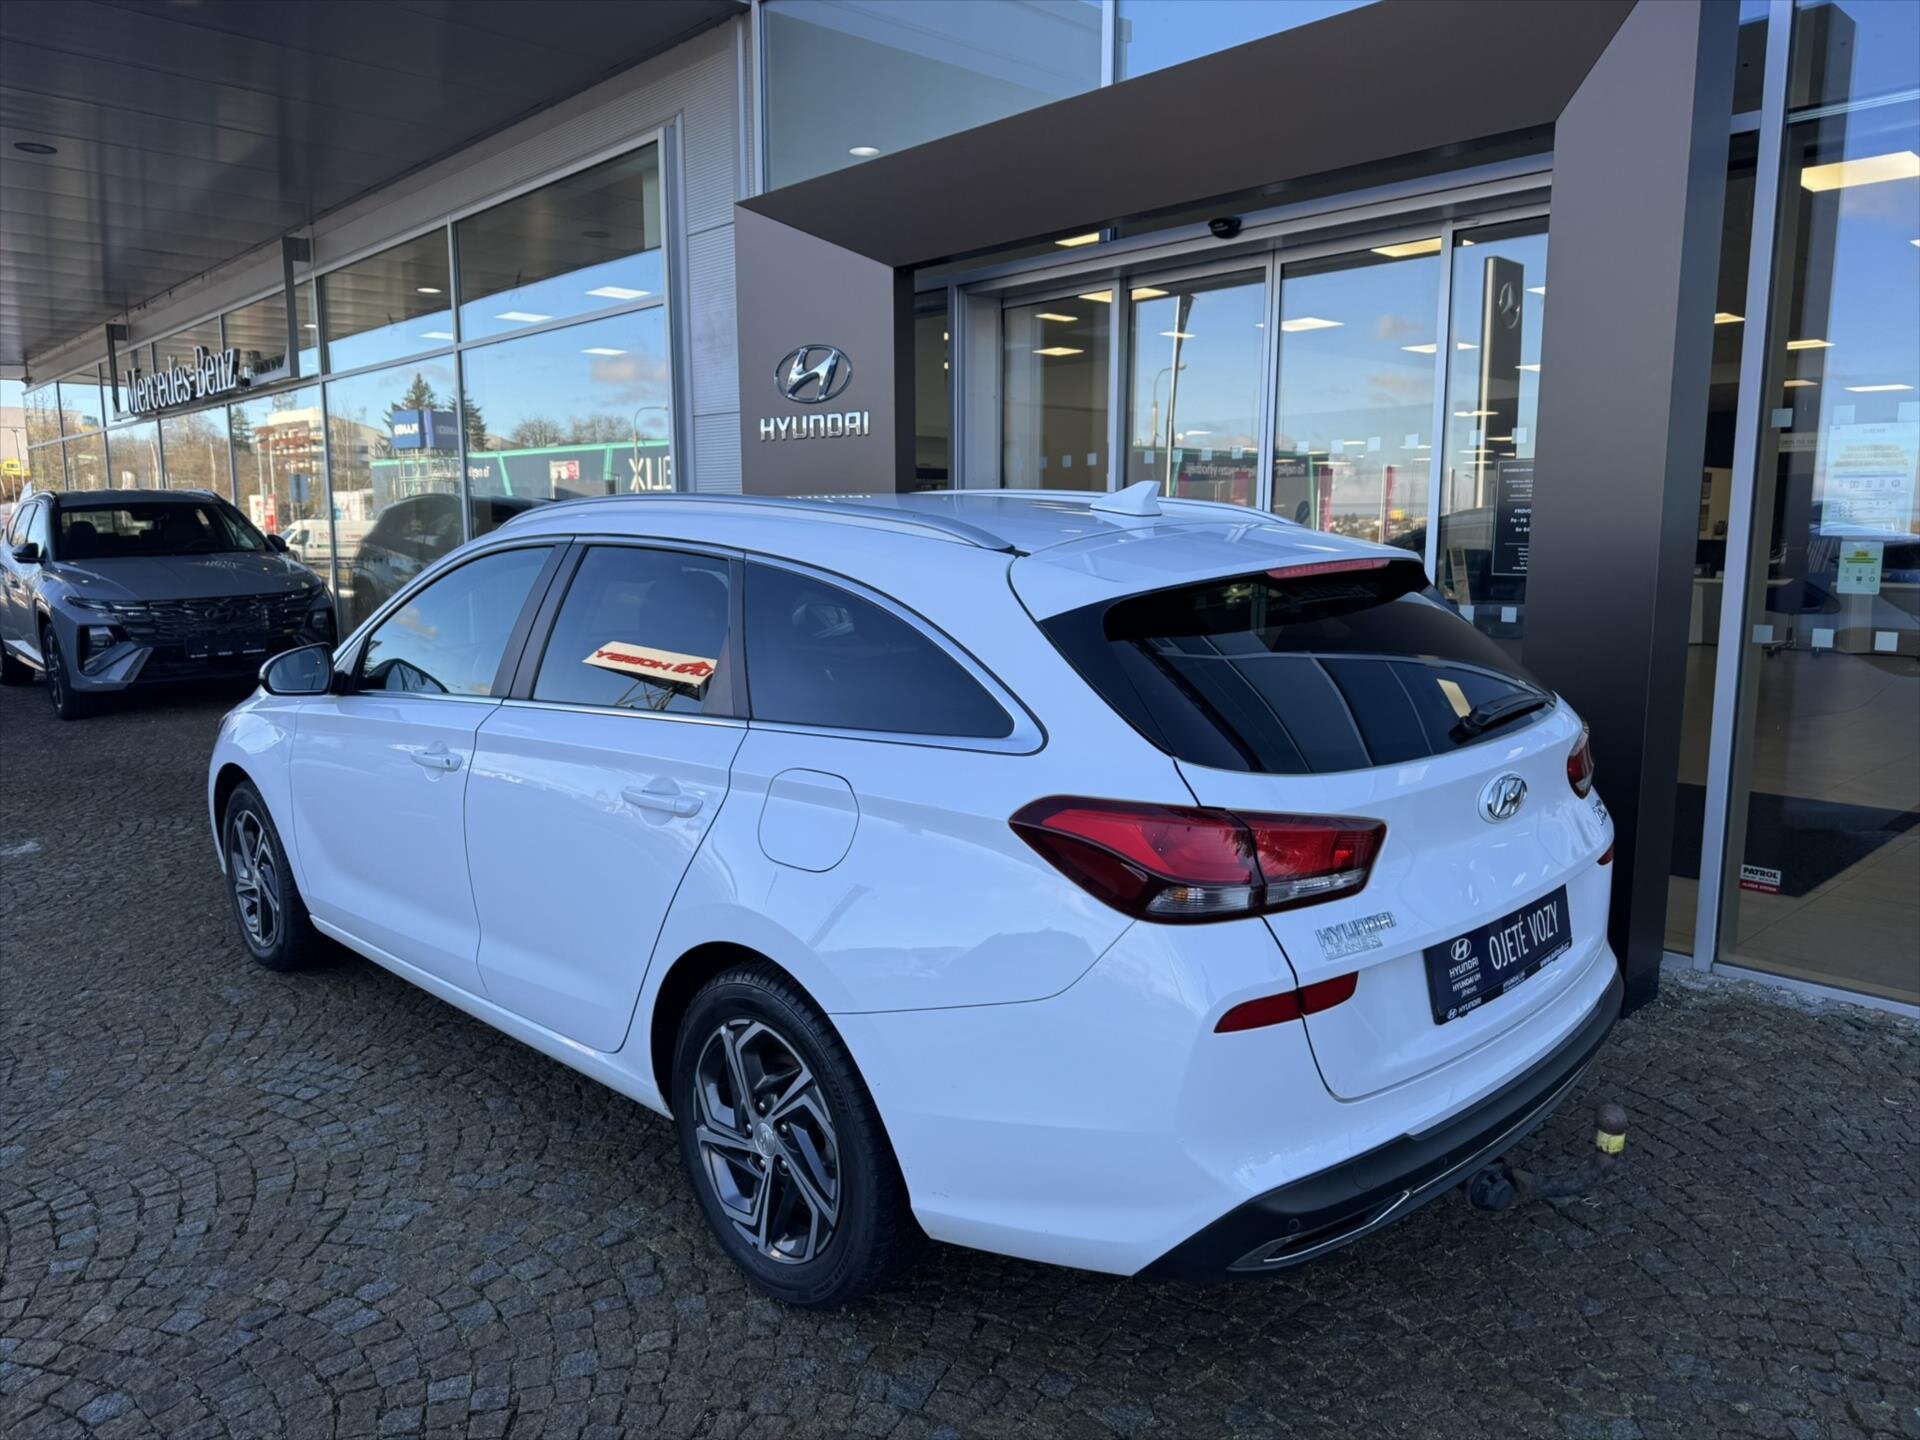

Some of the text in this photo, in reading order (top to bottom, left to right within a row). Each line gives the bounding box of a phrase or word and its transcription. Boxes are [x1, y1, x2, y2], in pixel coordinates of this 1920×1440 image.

[125, 345, 239, 414] Mercedes-Benz
[760, 411, 869, 441] HYUNDAI
[1743, 866, 1779, 880] PATROL
[1315, 911, 1396, 946] HYUNDAI
[1488, 900, 1559, 970] OJETÉ VOZY
[1449, 956, 1480, 978] HYUNDAI
